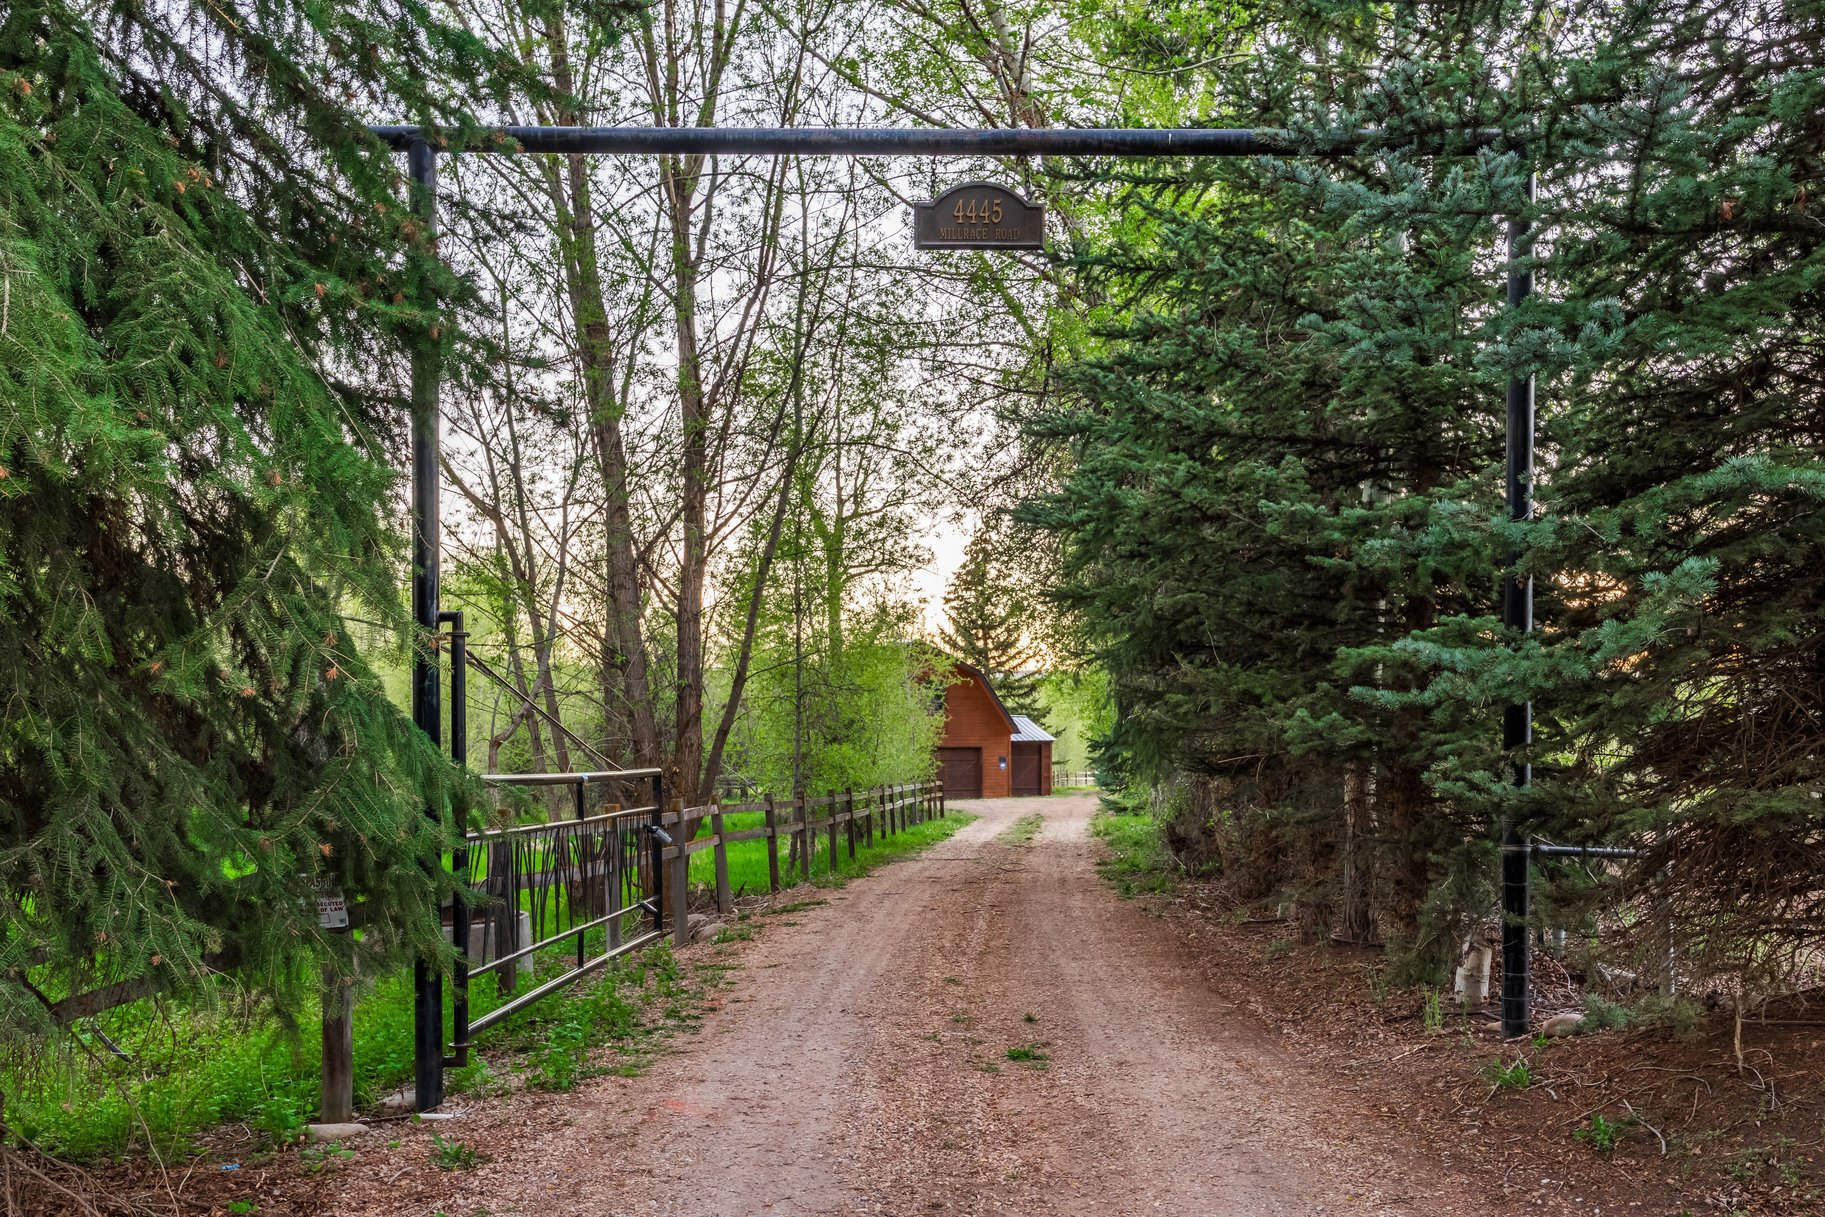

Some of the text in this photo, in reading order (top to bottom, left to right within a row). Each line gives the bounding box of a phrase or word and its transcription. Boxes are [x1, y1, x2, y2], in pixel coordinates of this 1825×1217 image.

[953, 198, 1003, 224] 4445
[939, 228, 1020, 240] MILLRACE ROAD
